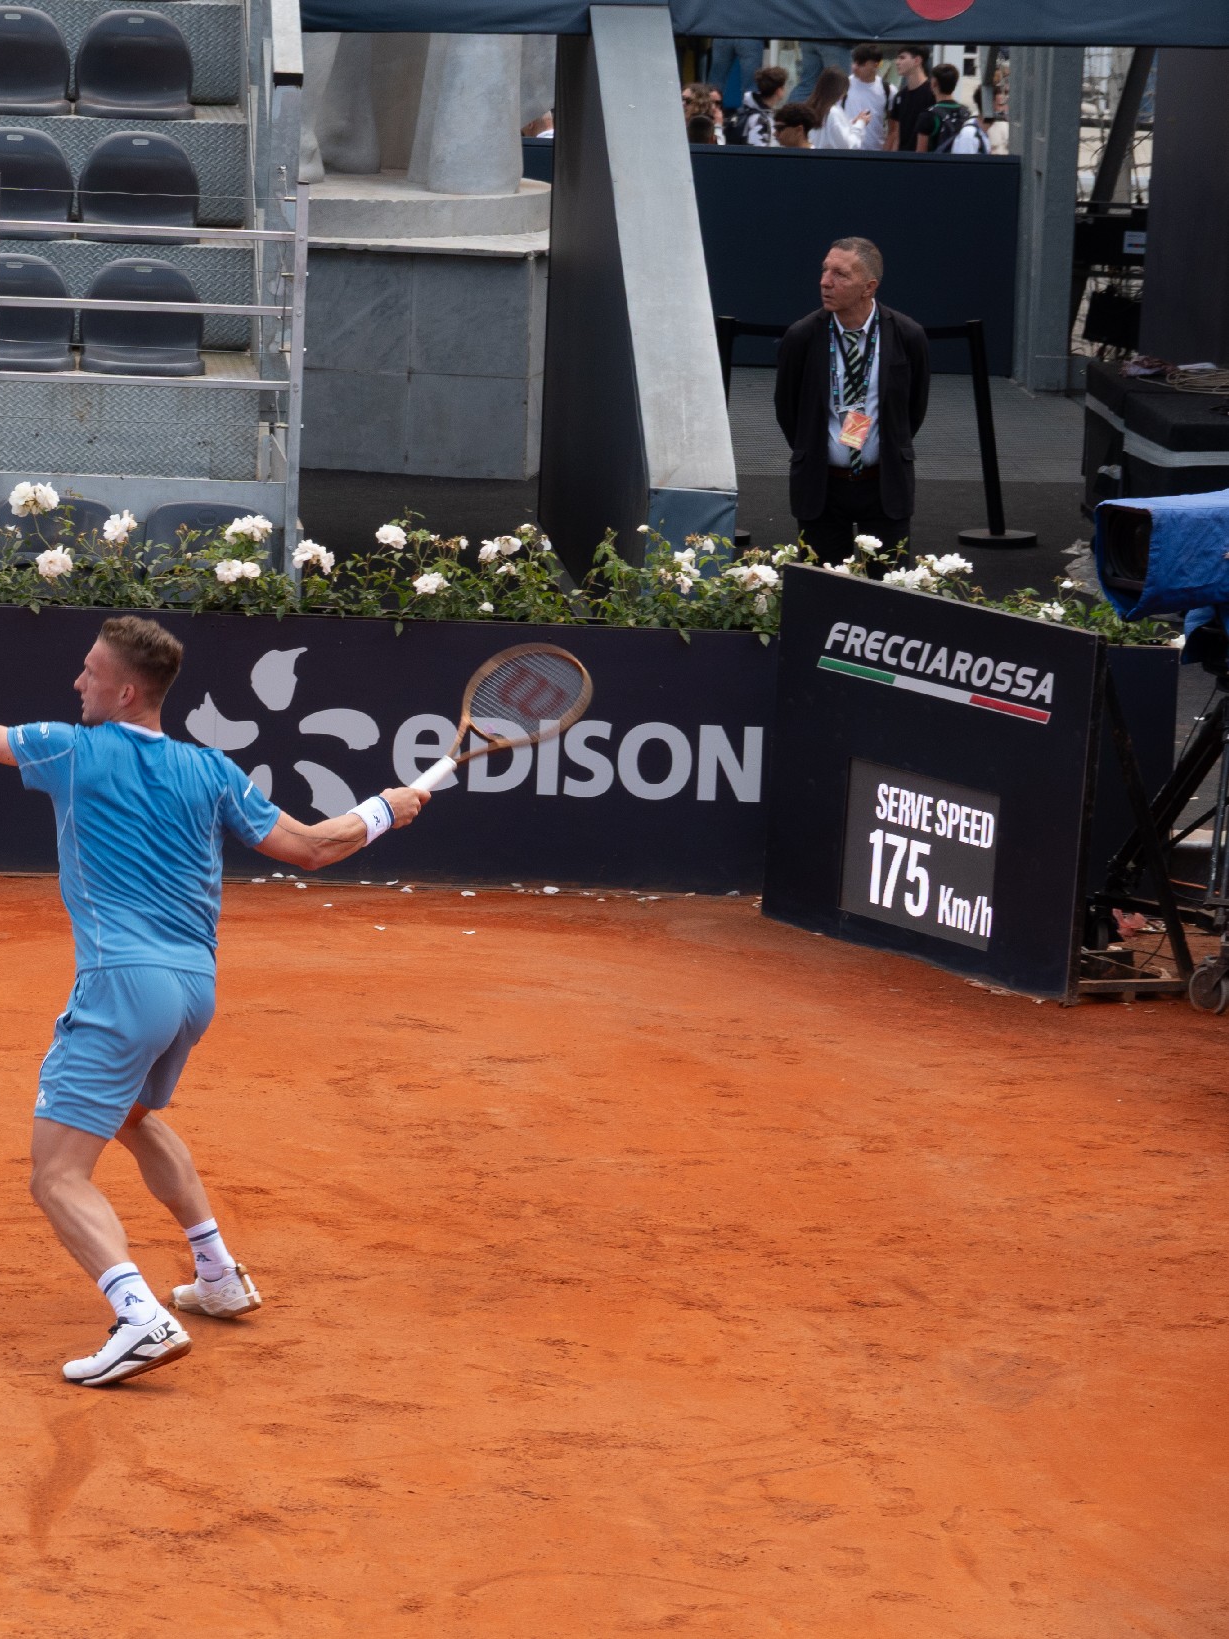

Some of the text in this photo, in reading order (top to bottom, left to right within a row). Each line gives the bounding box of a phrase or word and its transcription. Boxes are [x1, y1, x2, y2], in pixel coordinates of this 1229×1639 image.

[824, 621, 1054, 704] FRECCIAROSSA
[875, 783, 995, 849] SERVE SPEED
[868, 828, 993, 938] 175 Km/h
